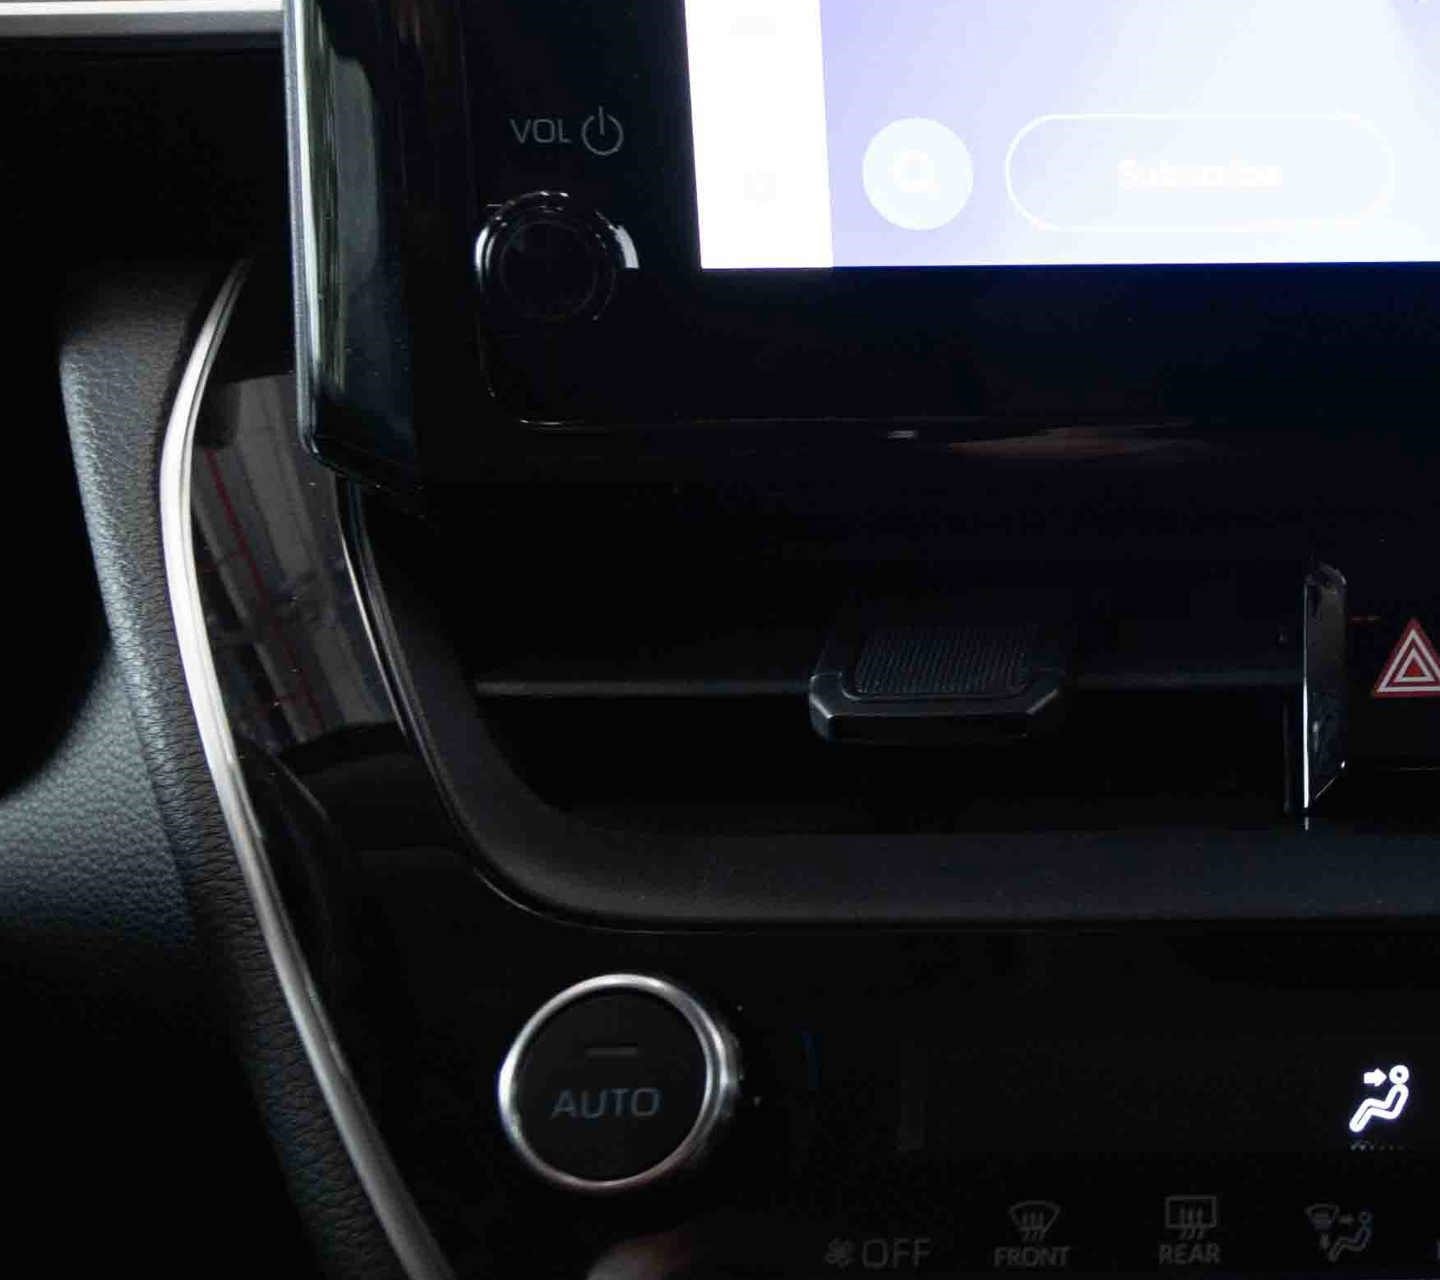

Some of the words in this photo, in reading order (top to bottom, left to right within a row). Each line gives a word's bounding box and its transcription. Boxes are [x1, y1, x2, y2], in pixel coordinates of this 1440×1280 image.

[509, 118, 572, 145] VOL
[548, 1086, 662, 1121] AUTO
[861, 1237, 933, 1269] OFF
[992, 1244, 1071, 1269] FRONT
[1158, 1241, 1223, 1266] REAR
